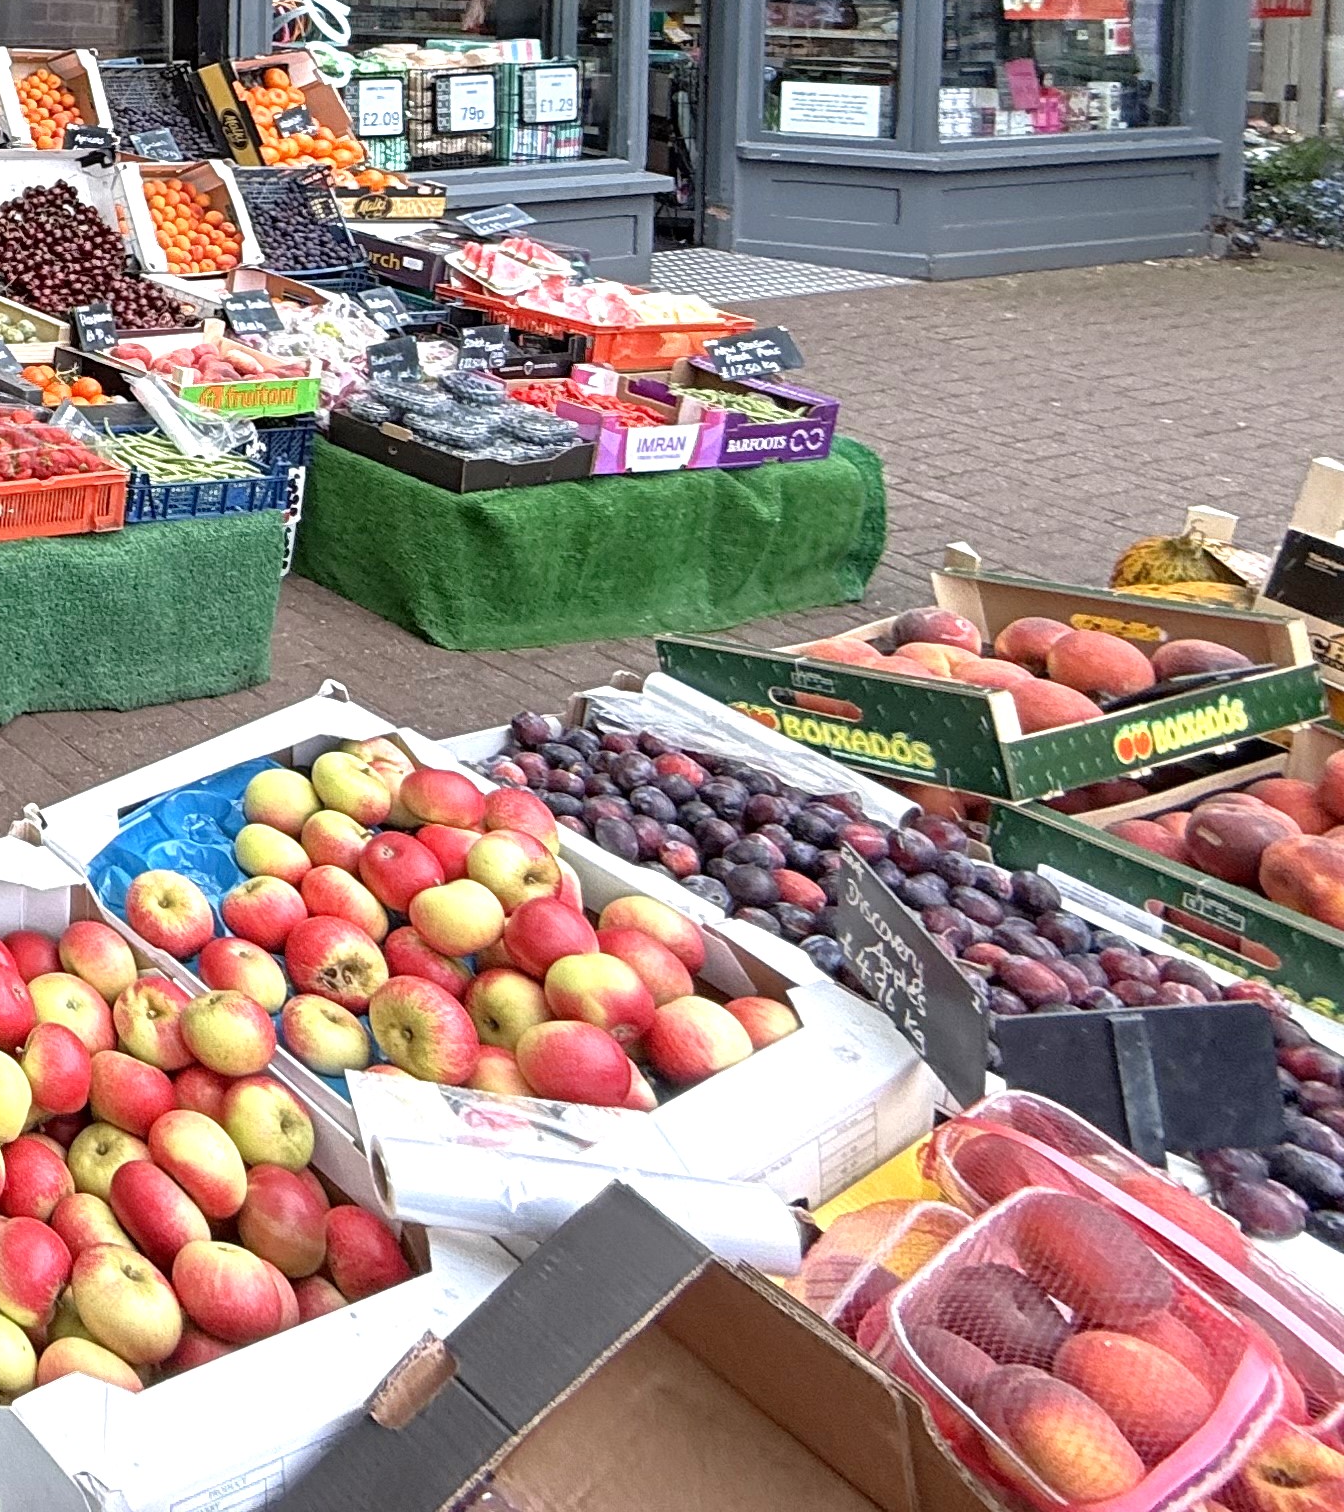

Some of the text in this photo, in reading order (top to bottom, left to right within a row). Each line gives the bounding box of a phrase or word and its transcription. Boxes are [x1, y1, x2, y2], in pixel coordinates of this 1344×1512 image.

[460, 106, 485, 123] 79p
[539, 97, 574, 113] £1.29
[362, 111, 400, 128] £2.09
[636, 435, 687, 454] IMRAN
[726, 435, 788, 454] BARFOOTS
[781, 713, 936, 770] BOIXADÓS
[845, 878, 924, 978] Discovery
[865, 941, 927, 1018] Apples
